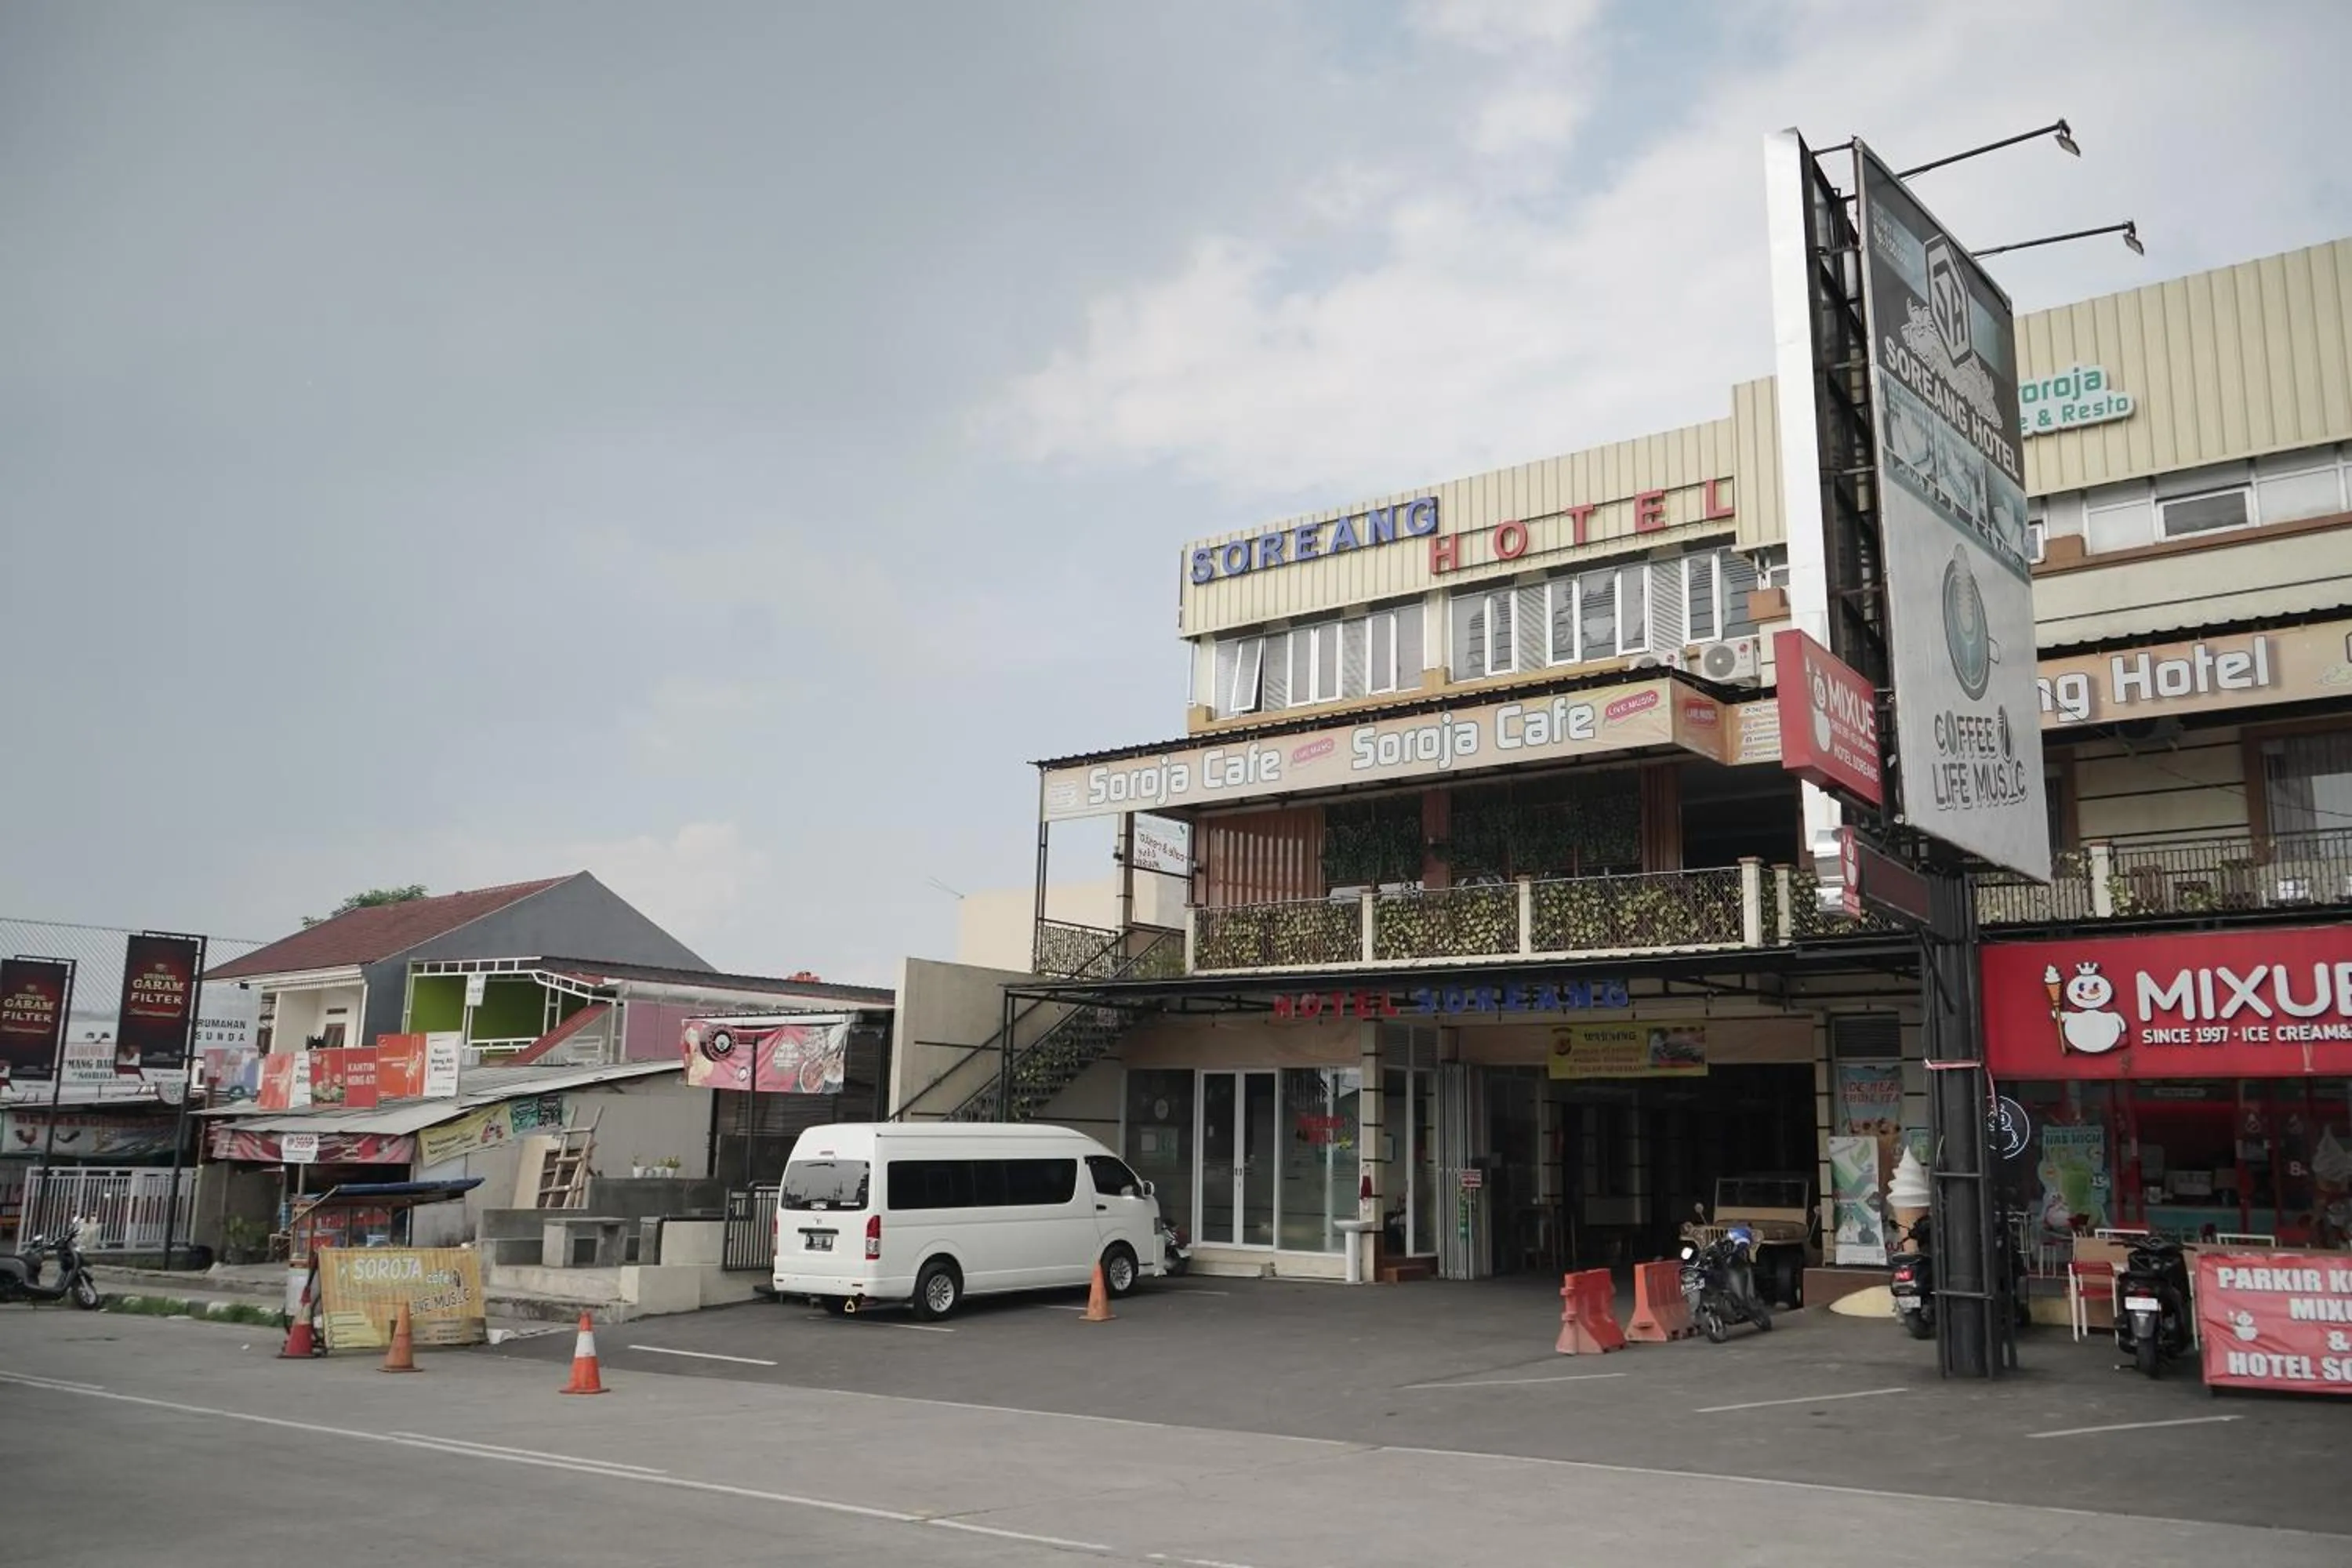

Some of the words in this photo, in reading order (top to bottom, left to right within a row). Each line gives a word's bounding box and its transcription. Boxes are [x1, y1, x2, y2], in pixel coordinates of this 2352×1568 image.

[2020, 366, 2102, 401] oroja
[1885, 336, 1968, 432] SOREANG
[1971, 412, 2020, 481] HOTEL
[2038, 408, 2053, 427] &
[2062, 394, 2129, 423] Resto
[1189, 496, 1439, 585] SOREANG
[1429, 477, 1735, 575] HOTEL
[2111, 635, 2270, 704] Hotel
[1828, 673, 1876, 742] MIXUE
[1352, 712, 1479, 770] Soroja
[1495, 696, 1595, 750] Cafe
[1087, 755, 1190, 807] Soroja
[1203, 742, 1282, 789] Cafe
[1933, 763, 1970, 809] LIFE
[1973, 759, 2027, 806] MUSIC
[130, 992, 183, 1004] FILTER
[132, 978, 184, 993] GARAM
[1272, 989, 1400, 1018] HOTEL
[1415, 978, 1628, 1015] SOREANG
[2, 1011, 52, 1023] FILTER
[3, 998, 55, 1011] GARAM
[2142, 1028, 2192, 1044] SINCE
[2196, 1026, 2229, 1043] 1997
[2241, 1025, 2270, 1042] ICE
[2276, 1023, 2352, 1041] CREAM&
[354, 1257, 423, 1281] SOROJA
[2217, 1267, 2322, 1292] PARKIR
[2328, 1269, 2352, 1293] K
[2328, 1330, 2351, 1352] &
[2227, 1351, 2317, 1380] HOTEL
